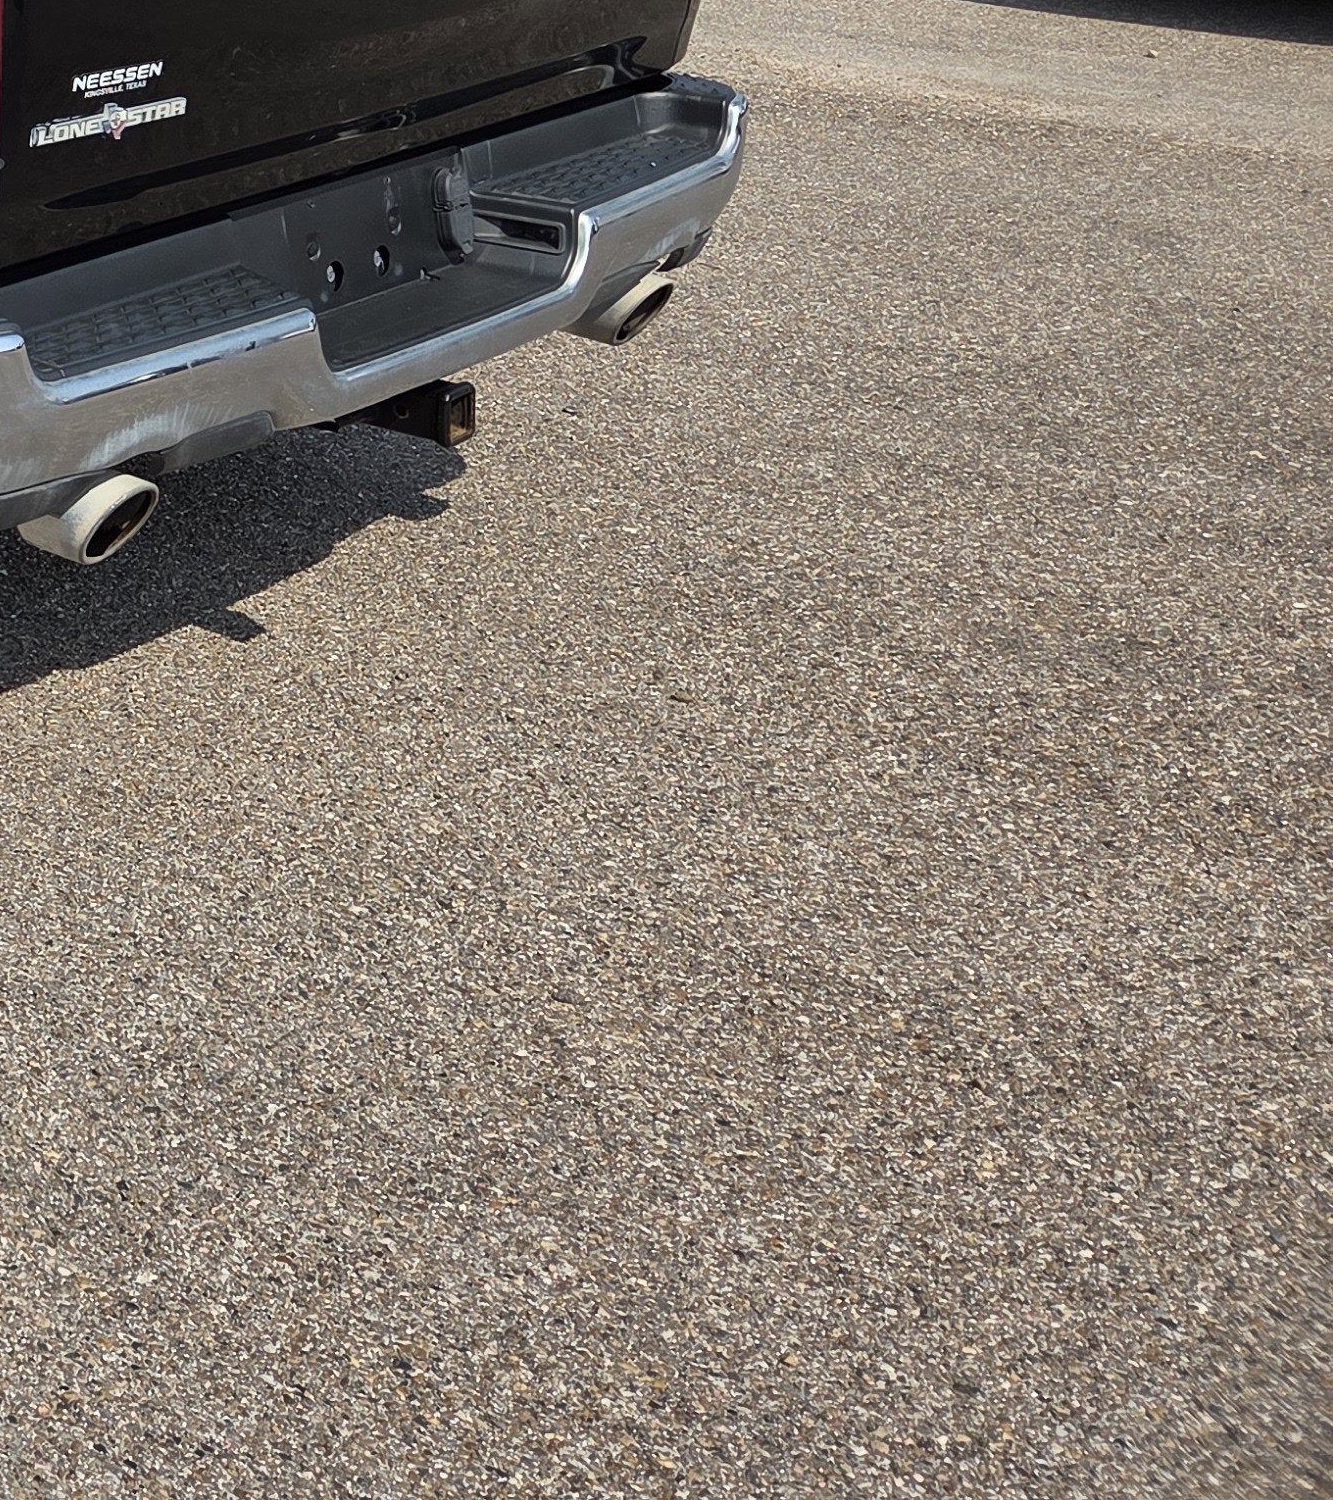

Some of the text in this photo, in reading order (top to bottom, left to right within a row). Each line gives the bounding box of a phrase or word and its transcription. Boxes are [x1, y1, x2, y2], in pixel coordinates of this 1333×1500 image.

[71, 61, 163, 92] NEESSEN
[126, 80, 147, 90] TEXAS
[36, 101, 186, 147] LONE STAR
